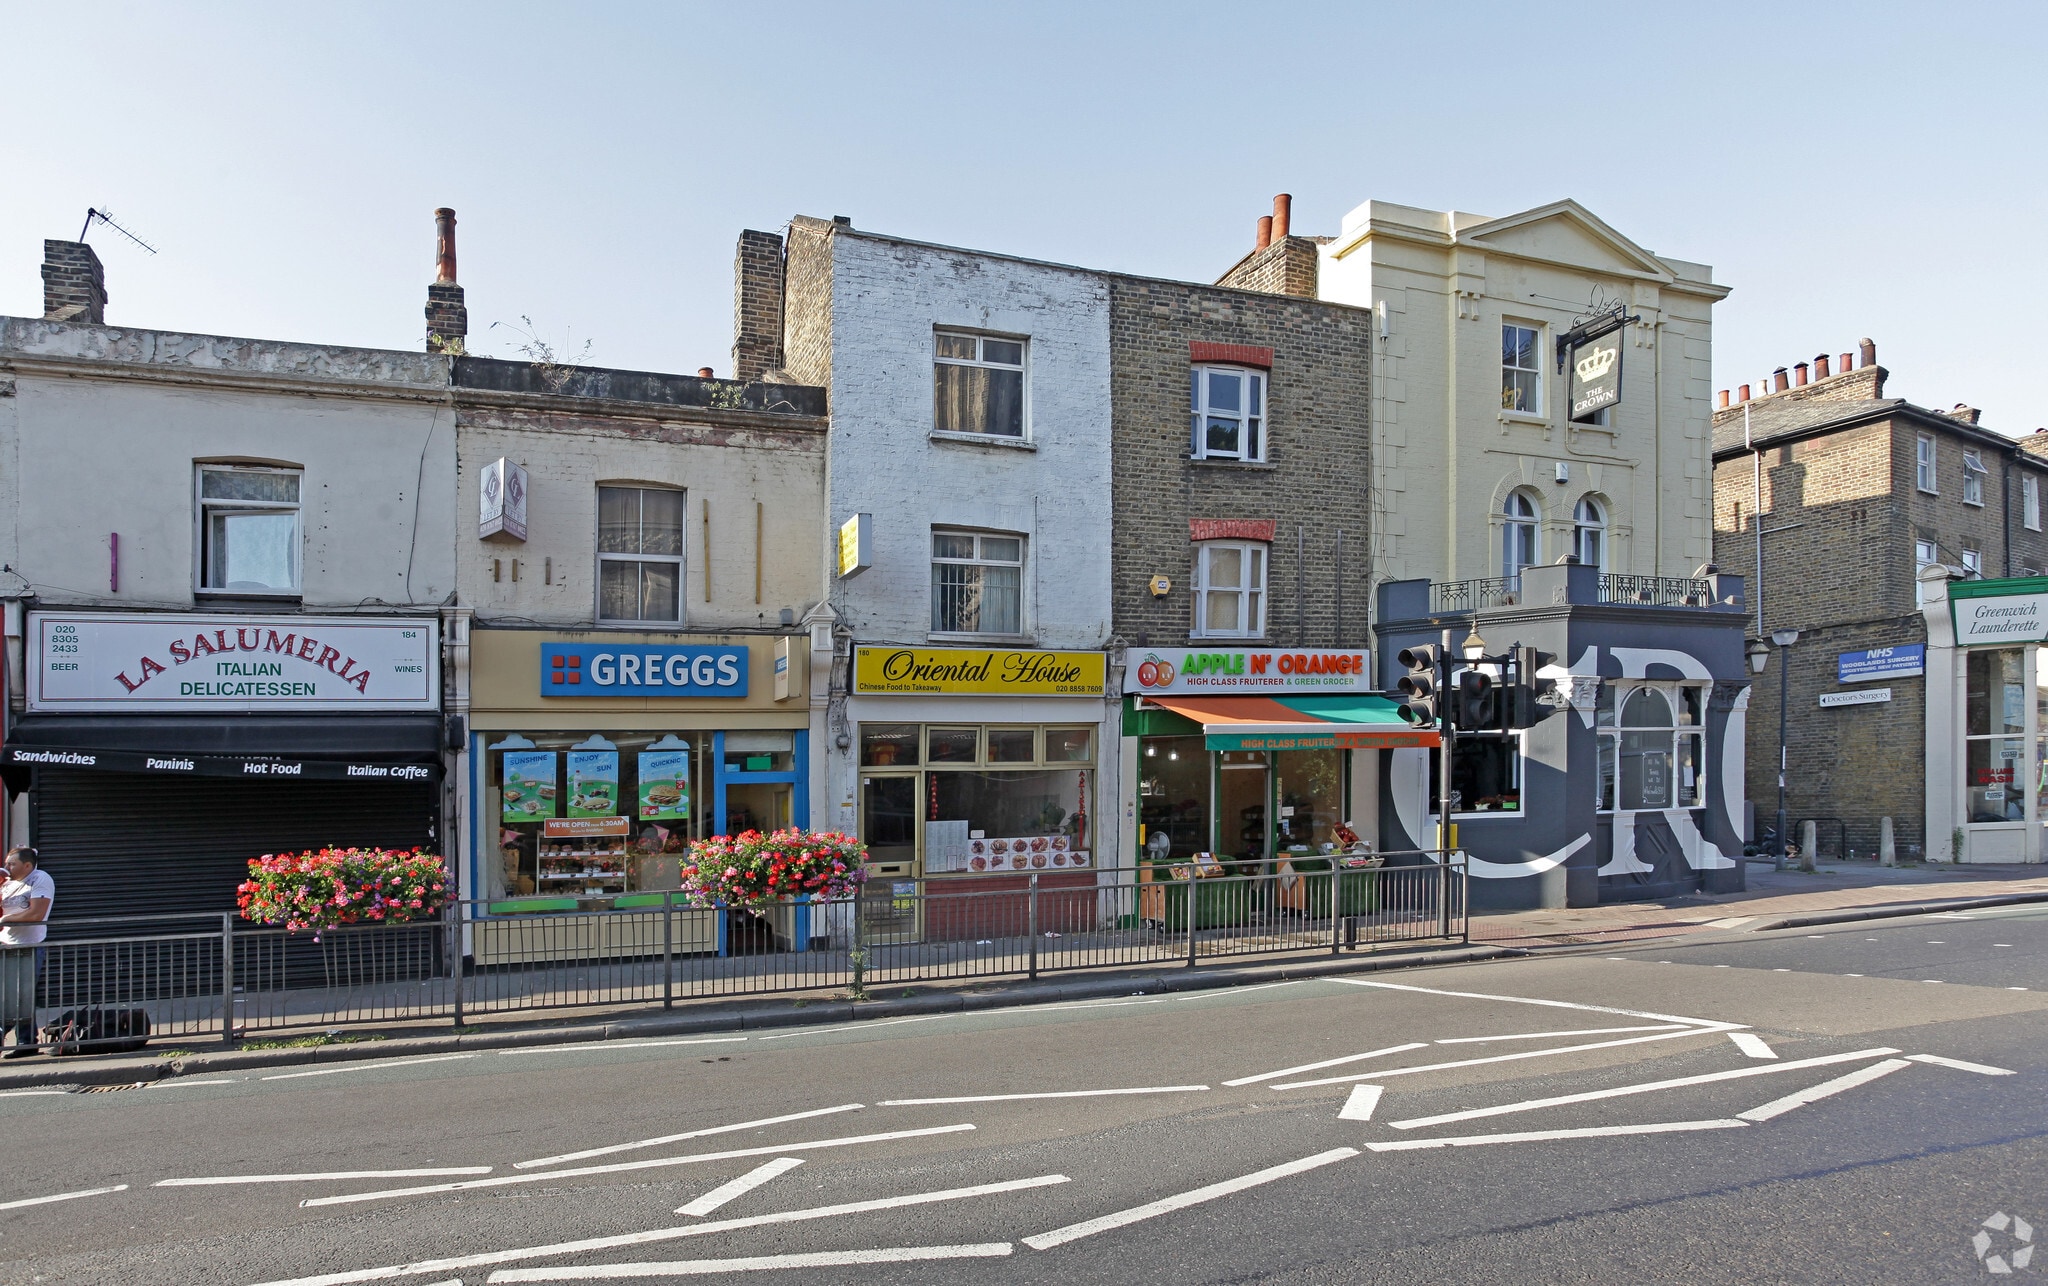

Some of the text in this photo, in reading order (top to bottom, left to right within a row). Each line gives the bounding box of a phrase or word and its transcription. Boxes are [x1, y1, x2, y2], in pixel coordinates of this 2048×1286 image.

[1586, 387, 1602, 398] THE
[1574, 391, 1614, 411] CROWN
[1975, 602, 2037, 618] Greenwich
[55, 625, 76, 634] 020
[1968, 620, 2040, 635] Launderette
[52, 635, 79, 643] 8305
[402, 631, 417, 639] 184
[52, 645, 78, 653] 2433
[1867, 647, 1894, 659] NHS
[51, 663, 79, 671] BEER
[113, 628, 371, 695] LA SALUMERIA
[883, 650, 1081, 683] Oriental House
[1180, 653, 1363, 676] APPLE N' ORANGE
[1841, 655, 1920, 669] WOODLANDS SURGERY
[216, 663, 282, 676] ITALIAN
[394, 665, 423, 673] WINES
[590, 653, 740, 687] GREGGS
[1840, 665, 1877, 674] REGISTERING
[911, 684, 942, 692] Takeaway
[1187, 678, 1209, 686] HIGH
[1210, 678, 1238, 686] CLASS
[1239, 678, 1284, 686] FRUITERER
[1294, 678, 1321, 686] GREEN
[180, 682, 316, 696] DELICATESSEN
[1827, 691, 1888, 703] Doctors Surgery
[1241, 739, 1265, 748] HIGH
[1267, 738, 1296, 748] CLASS
[13, 750, 96, 766] Sandwiches
[146, 758, 195, 770] Paninis
[509, 754, 548, 766] SUNSHINE
[574, 754, 600, 764] ENJOY
[650, 757, 681, 768] QUICKNIC
[243, 762, 302, 774] Hot Food
[347, 765, 428, 779] Italian Coffee
[596, 764, 612, 772] SUN
[1978, 775, 2014, 783] WASH
